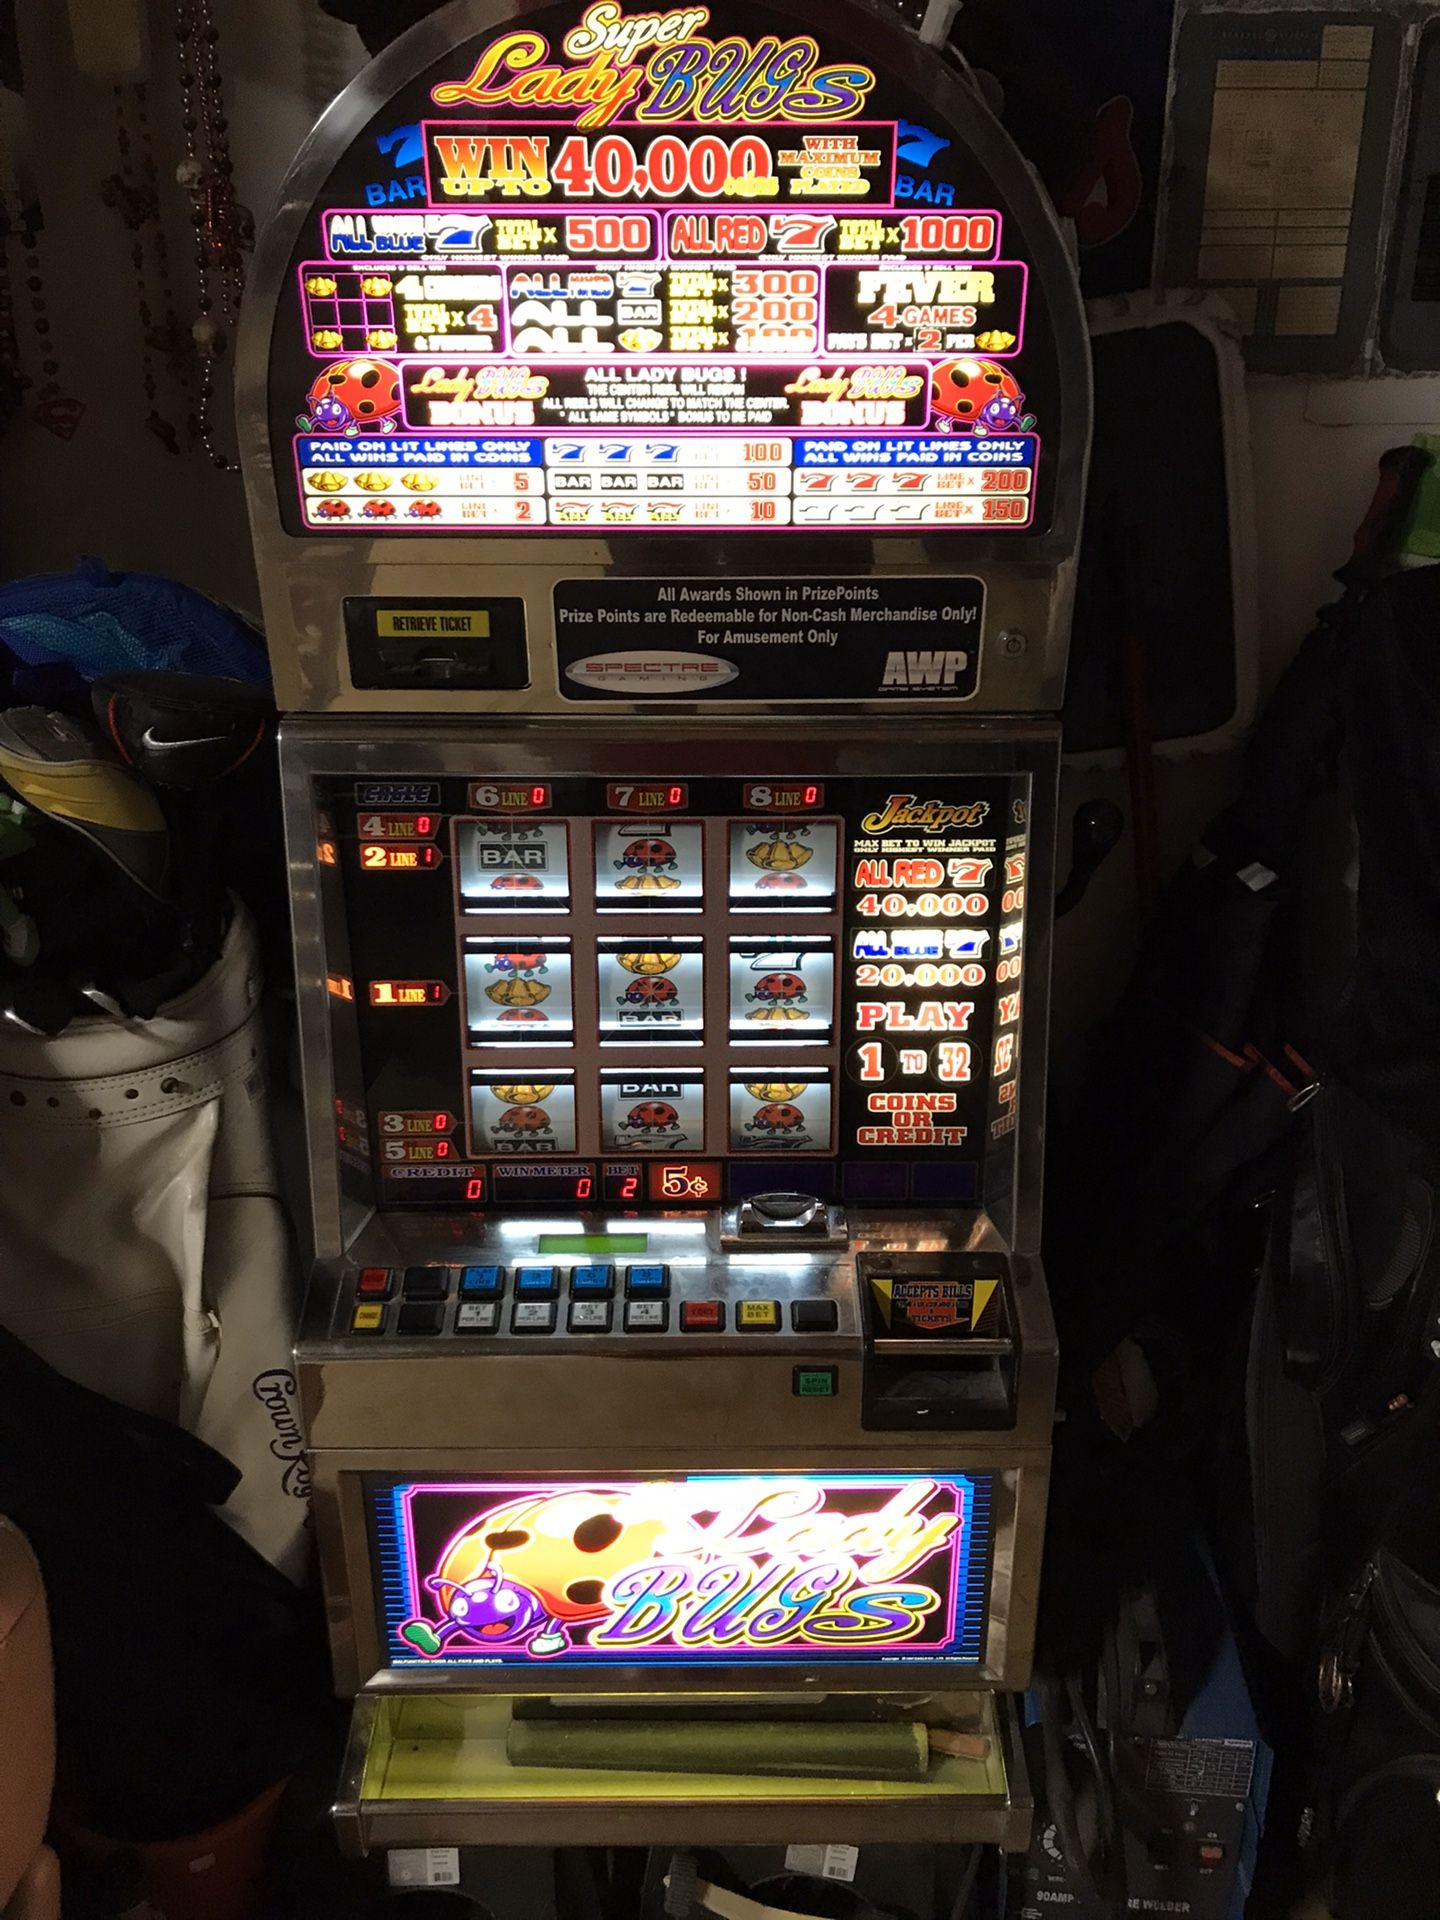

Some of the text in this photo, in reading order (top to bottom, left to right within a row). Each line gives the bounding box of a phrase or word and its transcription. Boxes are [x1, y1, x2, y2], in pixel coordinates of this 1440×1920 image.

[568, 2, 708, 64] Super
[433, 33, 647, 130] Lady
[803, 136, 858, 150] WITH
[434, 135, 773, 197] WIN 40,000
[778, 150, 881, 166] MAXIMUM
[800, 167, 860, 179] COINS
[365, 175, 427, 205] BAR
[441, 178, 551, 196] UP TO
[895, 175, 955, 205] BAR
[566, 216, 650, 251] 500
[672, 215, 837, 252] ALL RED 7
[900, 216, 993, 251] 1000
[732, 271, 818, 296] 300
[858, 272, 994, 302] FEVER
[468, 305, 497, 331] 4
[732, 298, 817, 324] 200
[868, 303, 976, 328] 4 GAMES
[919, 330, 941, 349] 2
[585, 367, 735, 382] ALL LADY BUGS
[681, 384, 706, 395] WILL
[543, 398, 562, 409] ALL
[599, 398, 624, 409] WILL
[671, 398, 685, 409] TO
[686, 398, 723, 409] MATCH
[724, 398, 745, 409] THE
[715, 412, 730, 422] TO
[732, 412, 746, 422] BE
[748, 412, 772, 422] PAID
[743, 443, 782, 462] 100
[804, 441, 1024, 452] PAID ON LIT LINES ONLY
[804, 452, 1023, 463] ALL WINS PAID IN COINS
[514, 472, 529, 491] 5
[555, 475, 591, 488] BAR
[601, 475, 637, 488] BAR
[647, 475, 683, 488] BAR
[748, 472, 776, 490] 50
[981, 470, 1028, 492] 200
[516, 502, 531, 521] 2
[752, 501, 775, 521] 10
[983, 499, 1026, 520] 150
[657, 586, 879, 601] All Awards Shown in PrizePoints
[393, 616, 472, 631] RETRIEVE TICKET
[559, 607, 977, 623] Prize Points are Redeemable for Non-Cash Merchandise Only!
[698, 629, 838, 646] For Amusement Only
[586, 663, 719, 672] SPECTRE
[882, 651, 967, 684] AWP
[476, 787, 544, 806] 6 LINE 0
[615, 787, 681, 806] 7 LINE 0
[750, 787, 816, 806] 8 LINE 0
[862, 795, 989, 834] Jackpot
[363, 816, 415, 836] 4 LINE
[364, 847, 417, 867] 2 LINE
[483, 850, 543, 863] BAR
[855, 858, 993, 887] ALL RED 7
[373, 984, 425, 1002] 1 LINE
[857, 1002, 974, 1030] PLAY
[858, 1043, 970, 1080] 1 TO 32
[868, 1093, 956, 1112] COINS
[384, 1115, 432, 1132] 3 LINE
[893, 1111, 932, 1128] OR
[857, 1127, 967, 1145] CREDIT
[385, 1141, 434, 1160] 5 LINE
[391, 1167, 475, 1178] CREDIT
[663, 1166, 708, 1197] 5¢
[467, 1180, 481, 1198] 0
[577, 1179, 591, 1198] 0
[622, 1178, 638, 1198] 2
[893, 1284, 972, 1299] ACCEPTS BILLS
[253, 1369, 302, 1450] Crown
[1036, 1890, 1074, 1903] 90AMP
